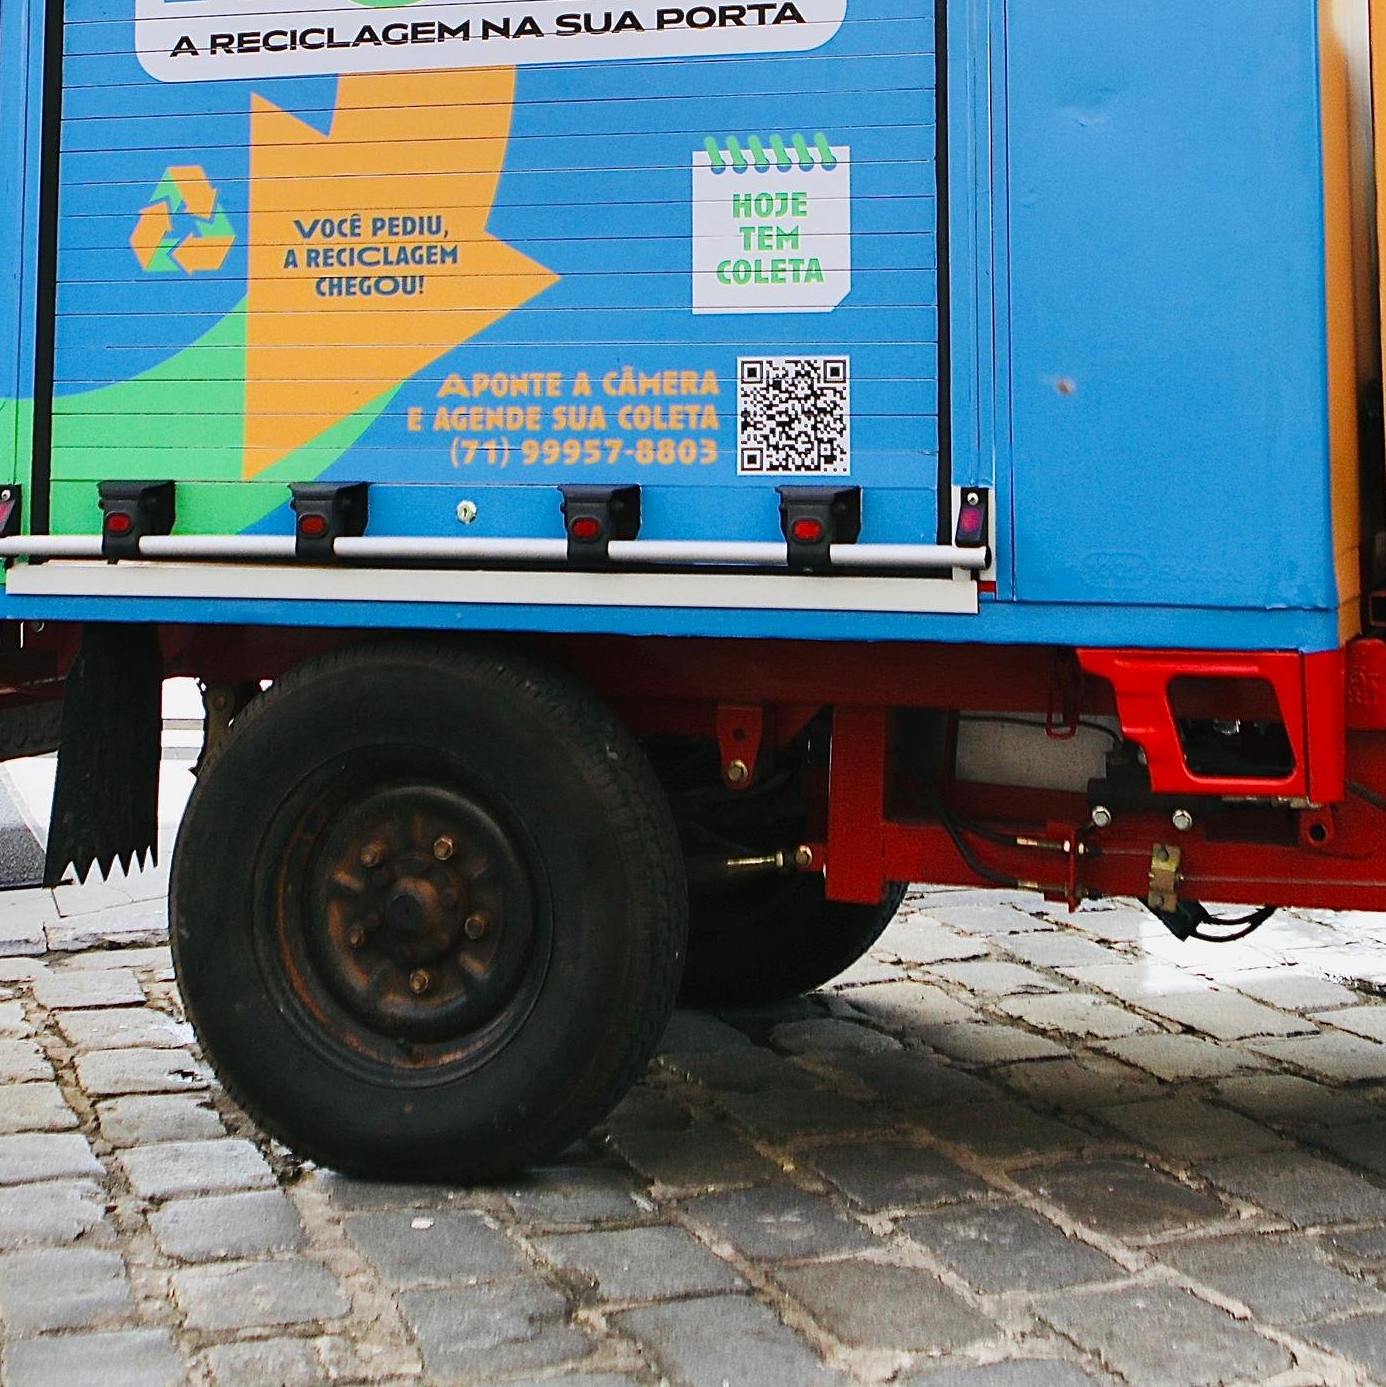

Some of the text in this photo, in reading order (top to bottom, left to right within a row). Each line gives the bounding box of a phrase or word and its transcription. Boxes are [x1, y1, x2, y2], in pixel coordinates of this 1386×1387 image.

[169, 1, 807, 57] A RECICLAGEM NA SUA PORTA
[732, 192, 808, 219] HOJE
[293, 213, 449, 240] VOCÊ PEDIU,
[739, 225, 800, 252] TEM
[283, 244, 459, 269] A RECICLAGEM
[315, 274, 425, 297] CHEGOU!
[716, 258, 825, 286] COLETA
[437, 366, 721, 398] APONTE A CÂMERA
[407, 405, 721, 432] E AGENDE SUA COLETA
[449, 437, 719, 469] (71) 99957-8803
